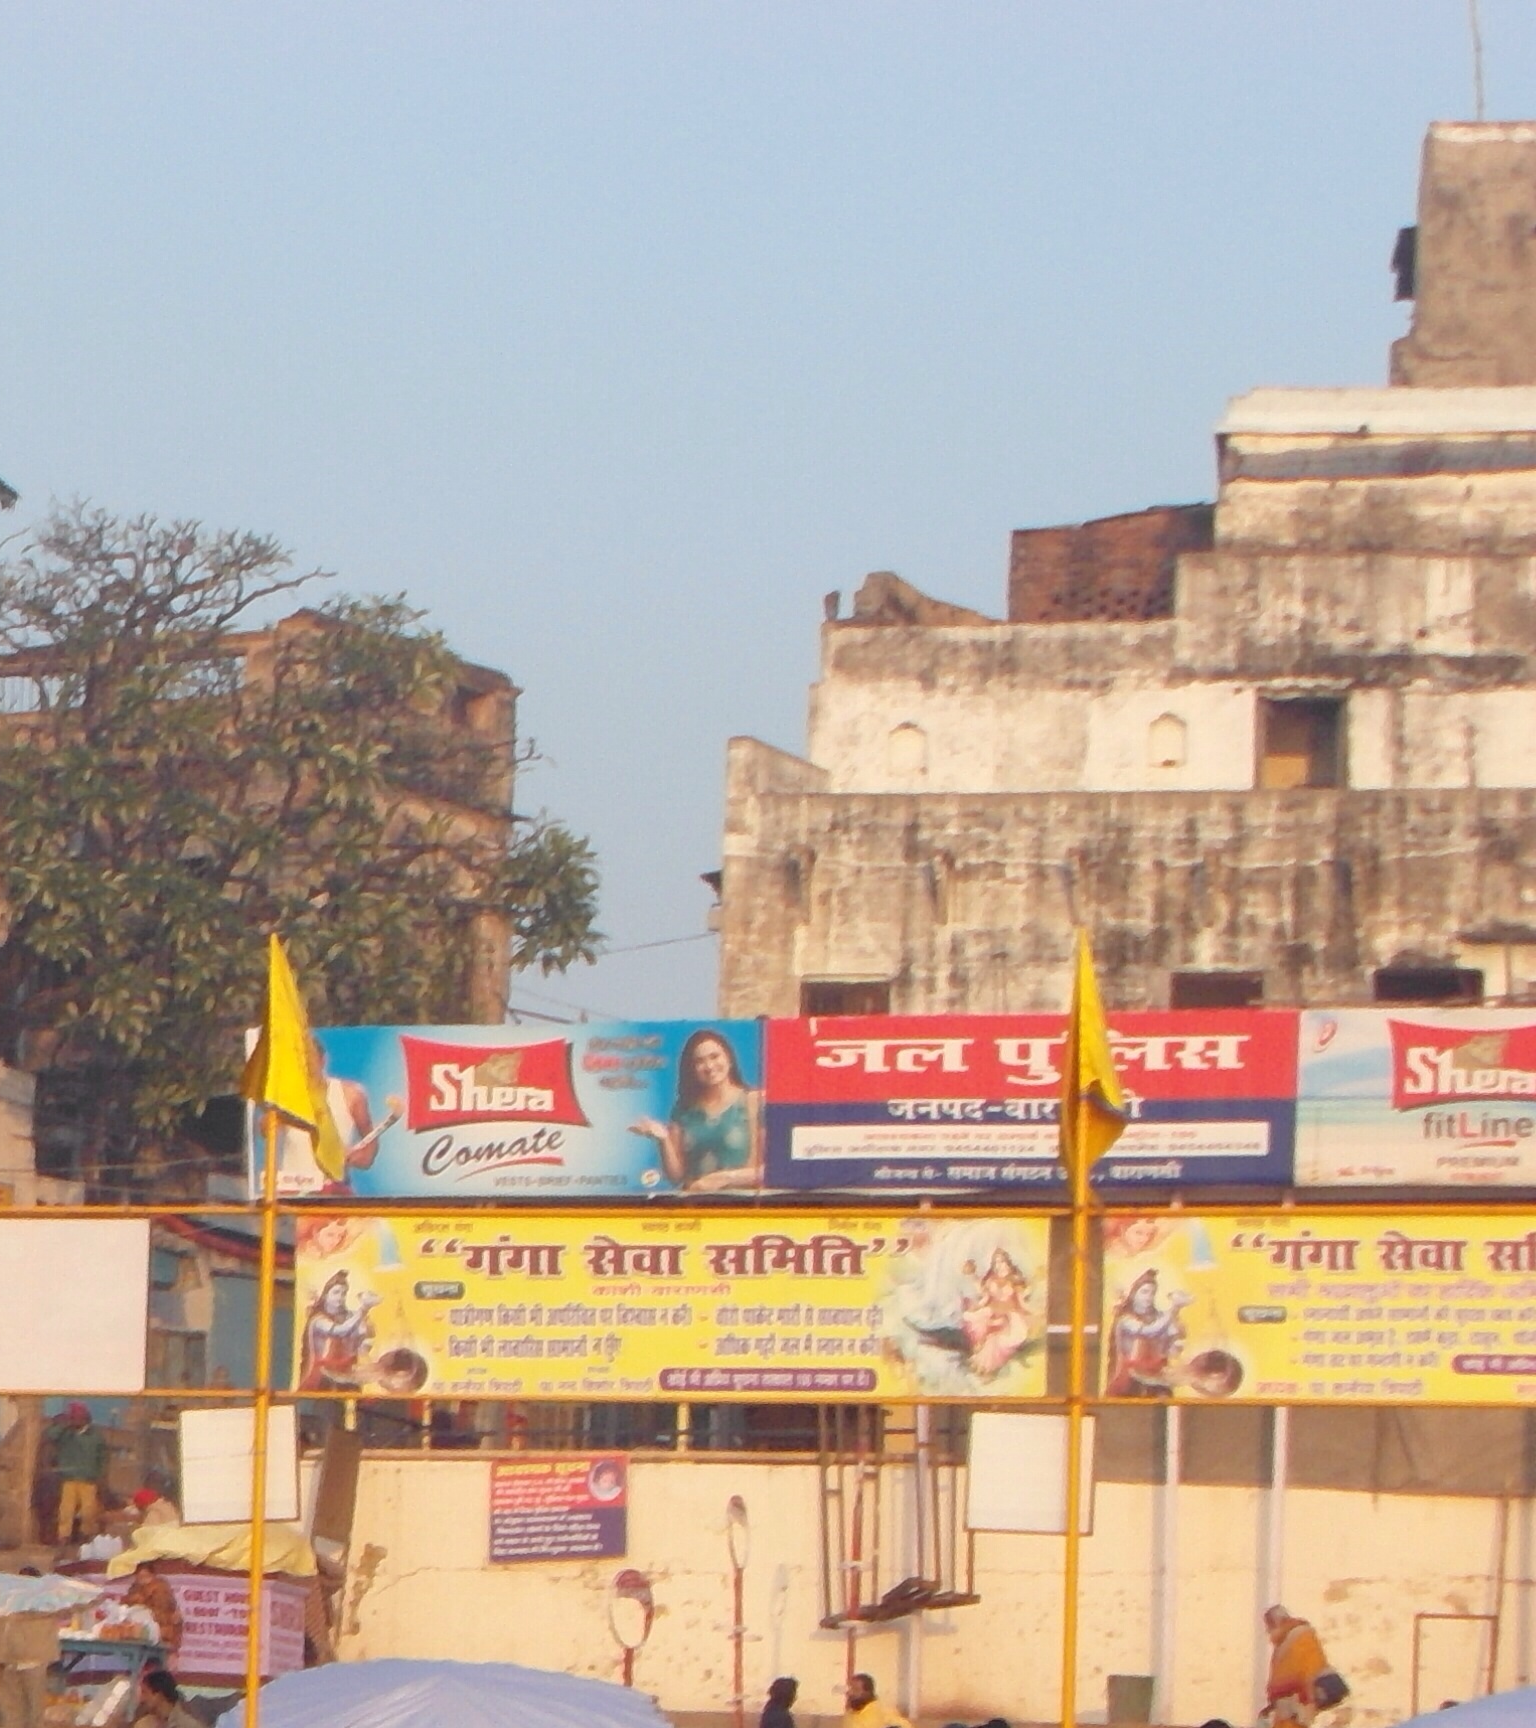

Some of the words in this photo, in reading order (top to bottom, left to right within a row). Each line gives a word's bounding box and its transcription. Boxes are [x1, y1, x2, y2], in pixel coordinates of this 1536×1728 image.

[813, 1037, 975, 1074] जल
[1403, 1046, 1536, 1095] Shera
[430, 1062, 555, 1112] Shera
[1422, 1111, 1534, 1140] fitLine
[421, 1128, 567, 1178] Comate
[583, 1234, 688, 1277] सेवा
[1377, 1230, 1468, 1272] सेवा
